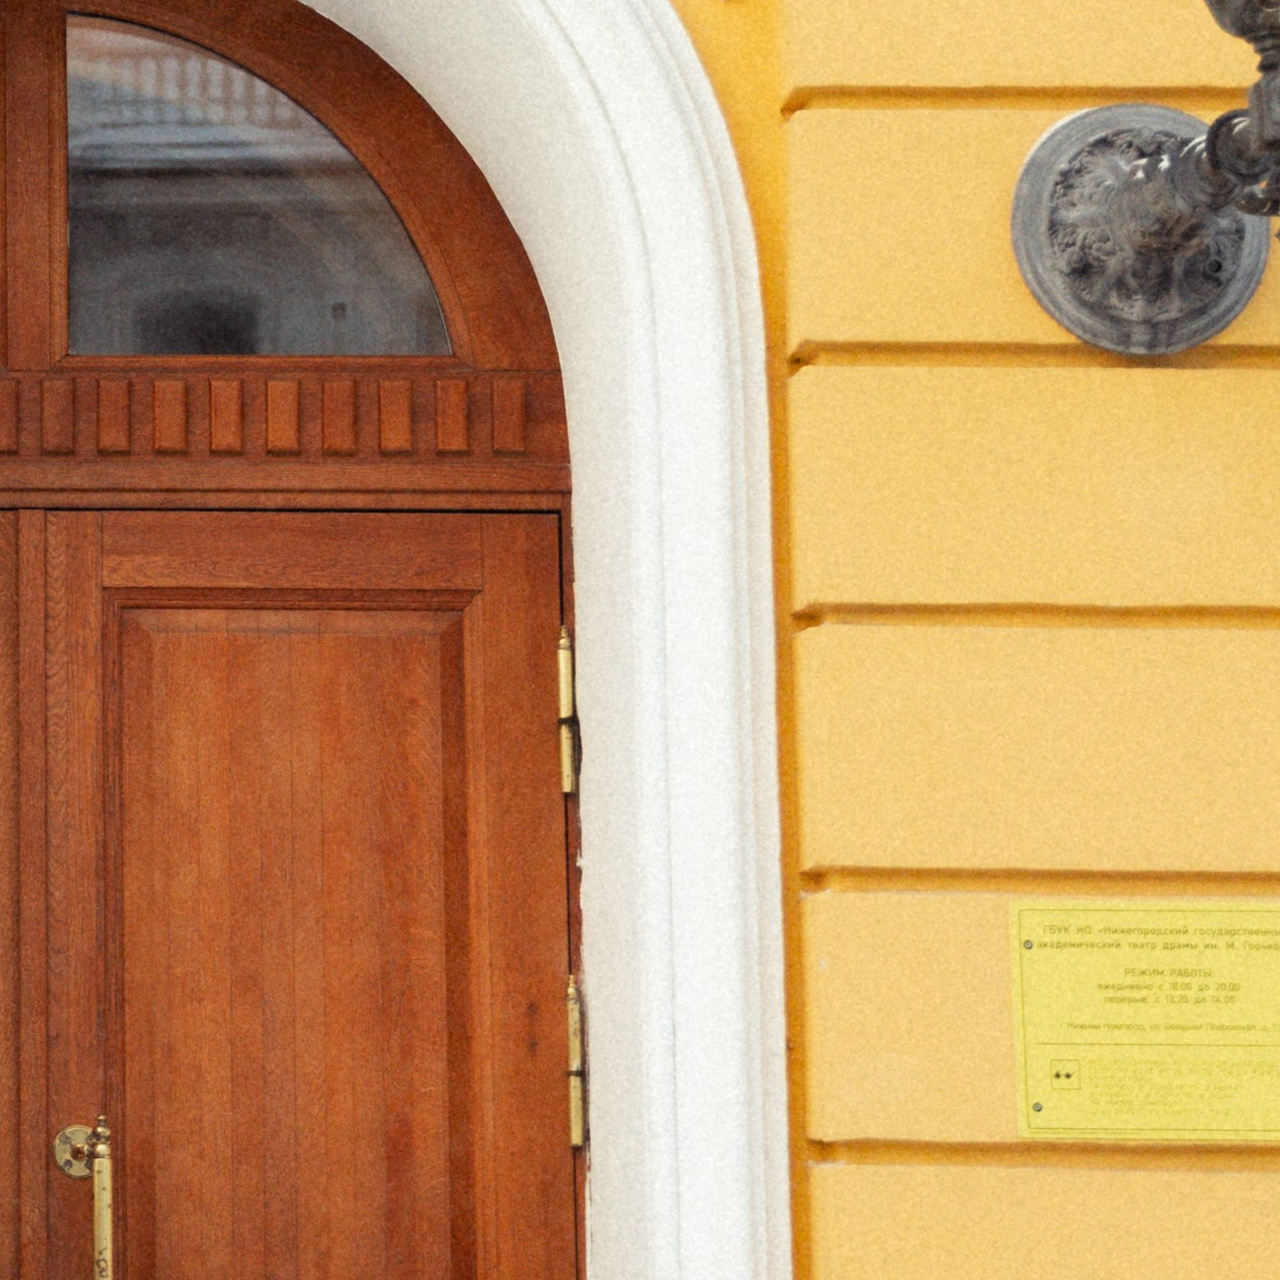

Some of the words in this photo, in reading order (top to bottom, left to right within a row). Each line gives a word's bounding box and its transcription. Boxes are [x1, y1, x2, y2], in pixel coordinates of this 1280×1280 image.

[1128, 942, 1157, 950] театр
[1162, 942, 1198, 951] драмы
[1124, 968, 1164, 977] РЕЖИМ
